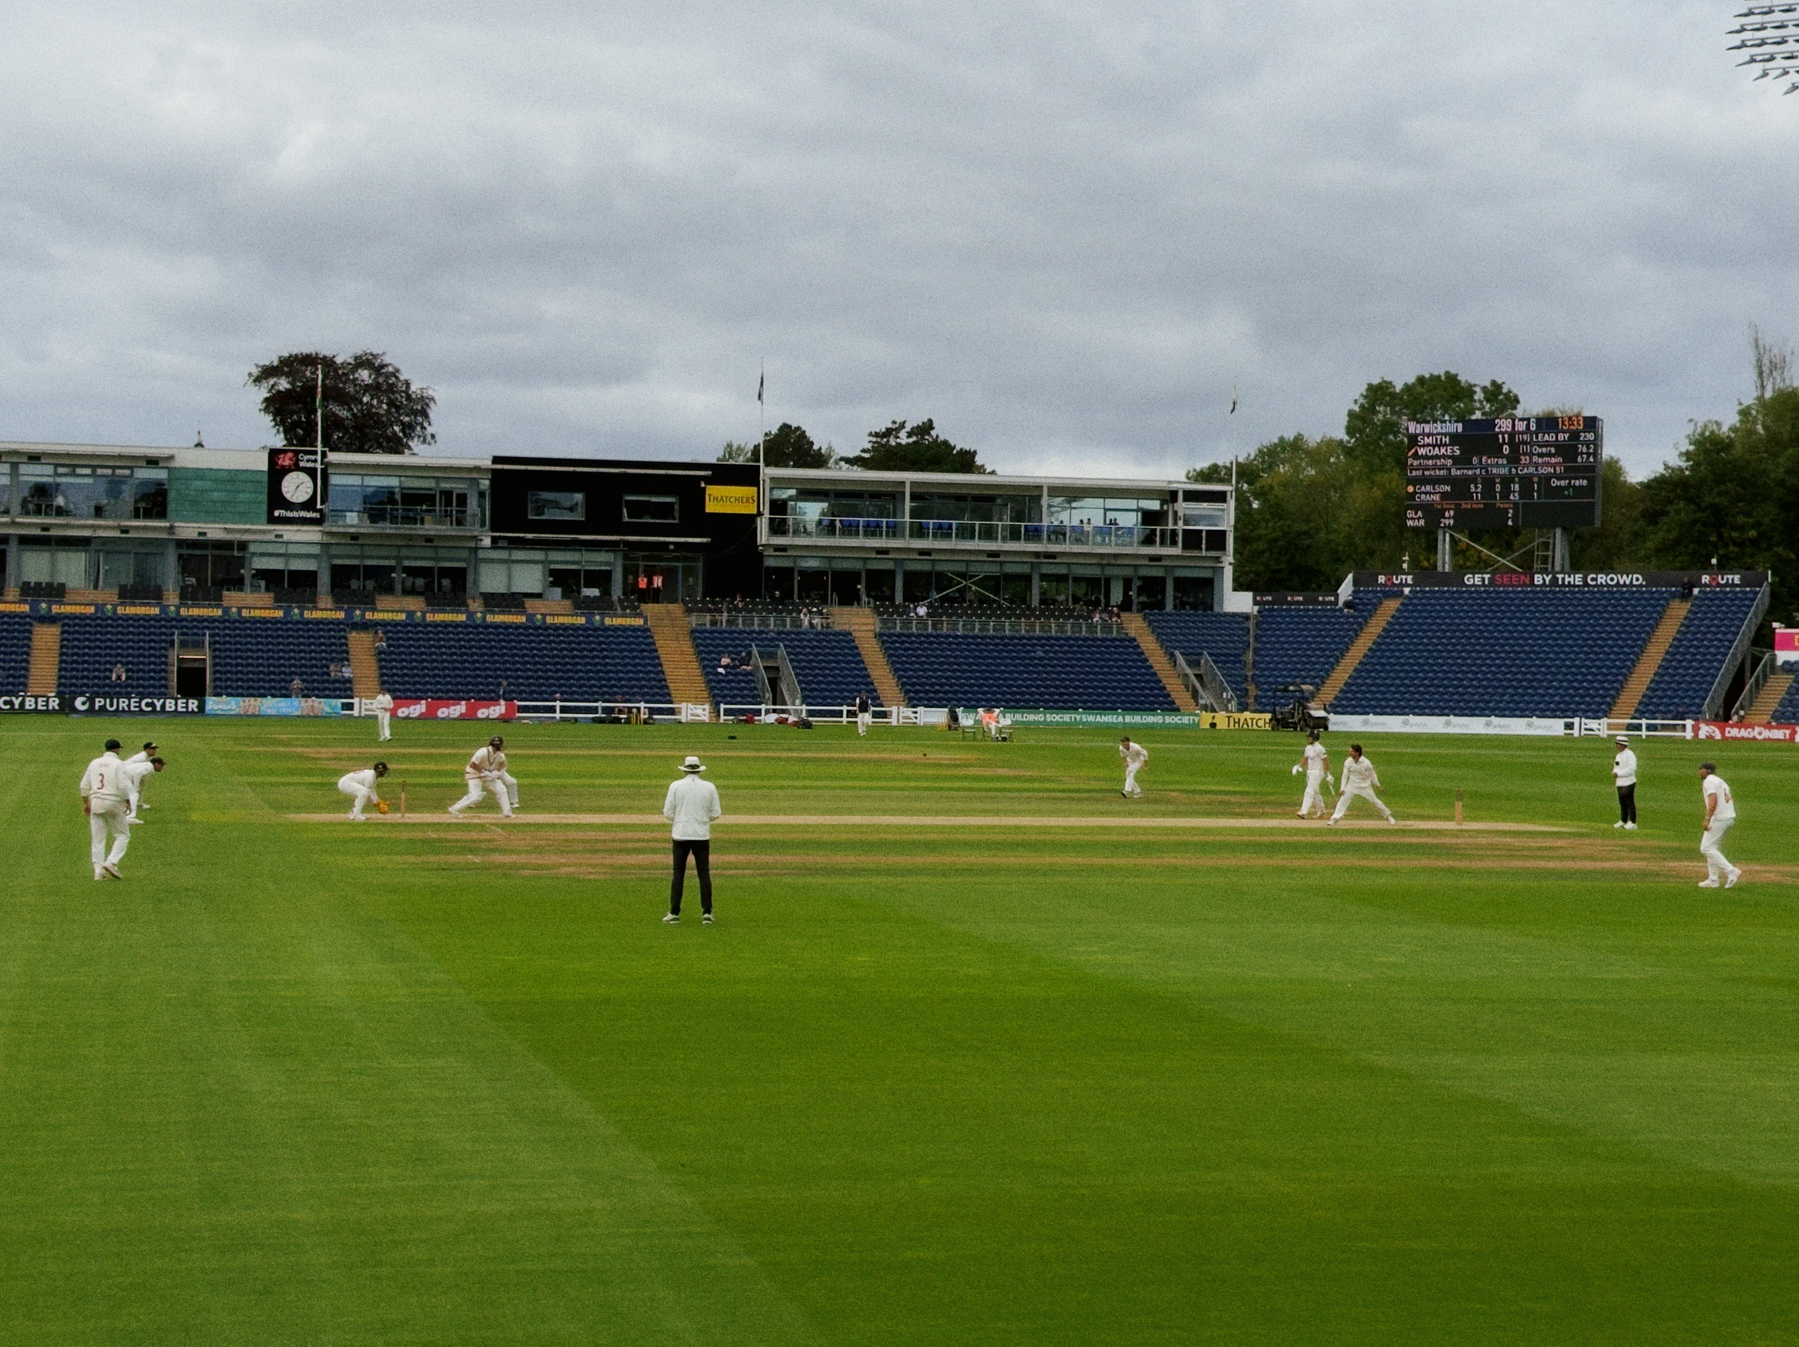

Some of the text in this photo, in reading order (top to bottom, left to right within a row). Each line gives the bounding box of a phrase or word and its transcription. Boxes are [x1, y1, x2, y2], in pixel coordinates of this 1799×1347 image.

[1408, 418, 1536, 434] Warwickshire 299 for 6
[1557, 416, 1584, 430] 13:33
[1417, 435, 1450, 445] SMITH
[1498, 434, 1508, 443] 11
[1532, 432, 1595, 441] LEAD BY 230
[1417, 446, 1460, 456] WOAKES
[1503, 445, 1509, 455] 0
[1532, 444, 1594, 454] Overs 76.2
[1407, 457, 1453, 467] Partnership
[1481, 456, 1507, 465] Extras
[1520, 455, 1530, 464] 33
[1532, 454, 1594, 464] Remain 67.4
[1407, 469, 1423, 477] Last
[1450, 467, 1480, 476] Barnard
[1488, 467, 1510, 475] TRIBE
[1517, 465, 1554, 475] CARLSON
[1550, 478, 1588, 487] Over rate
[1415, 485, 1451, 493] CARLSON
[1470, 484, 1482, 493] 5.2
[707, 494, 756, 505] THATCHERS
[1415, 493, 1441, 502] CRANE
[1472, 493, 1481, 501] 11
[274, 510, 320, 519] #ThisIsWales
[1406, 509, 1513, 519] GLA 69 2
[1406, 518, 1513, 527] WAR 299 4
[1464, 573, 1646, 586] GET SEEN BY THE CROWD.
[51, 604, 95, 614] GLAMORGAN
[117, 606, 160, 615] GLAMORGAN
[180, 607, 222, 617] GLAMORGAN
[242, 608, 284, 618] GLAMORGAN
[303, 610, 345, 619] GLAMORGAN
[365, 611, 406, 621] GLAMORGAN
[426, 612, 466, 622] GLAMORGAN
[486, 614, 526, 623] GLAMORGAN
[545, 615, 586, 625] GLAMORGAN
[604, 617, 644, 626] GLAMORGAN
[0, 697, 60, 710] CYBER
[94, 698, 199, 712] PURECYBER
[397, 701, 426, 717] ogi
[437, 701, 466, 718] ogi
[477, 701, 506, 719] ogi
[1045, 713, 1082, 722] SOCIETY
[1082, 714, 1200, 724] SWANSEA BUILDING SOCIETY
[1725, 726, 1790, 739] DRAGONBET
[97, 773, 105, 790] 3
